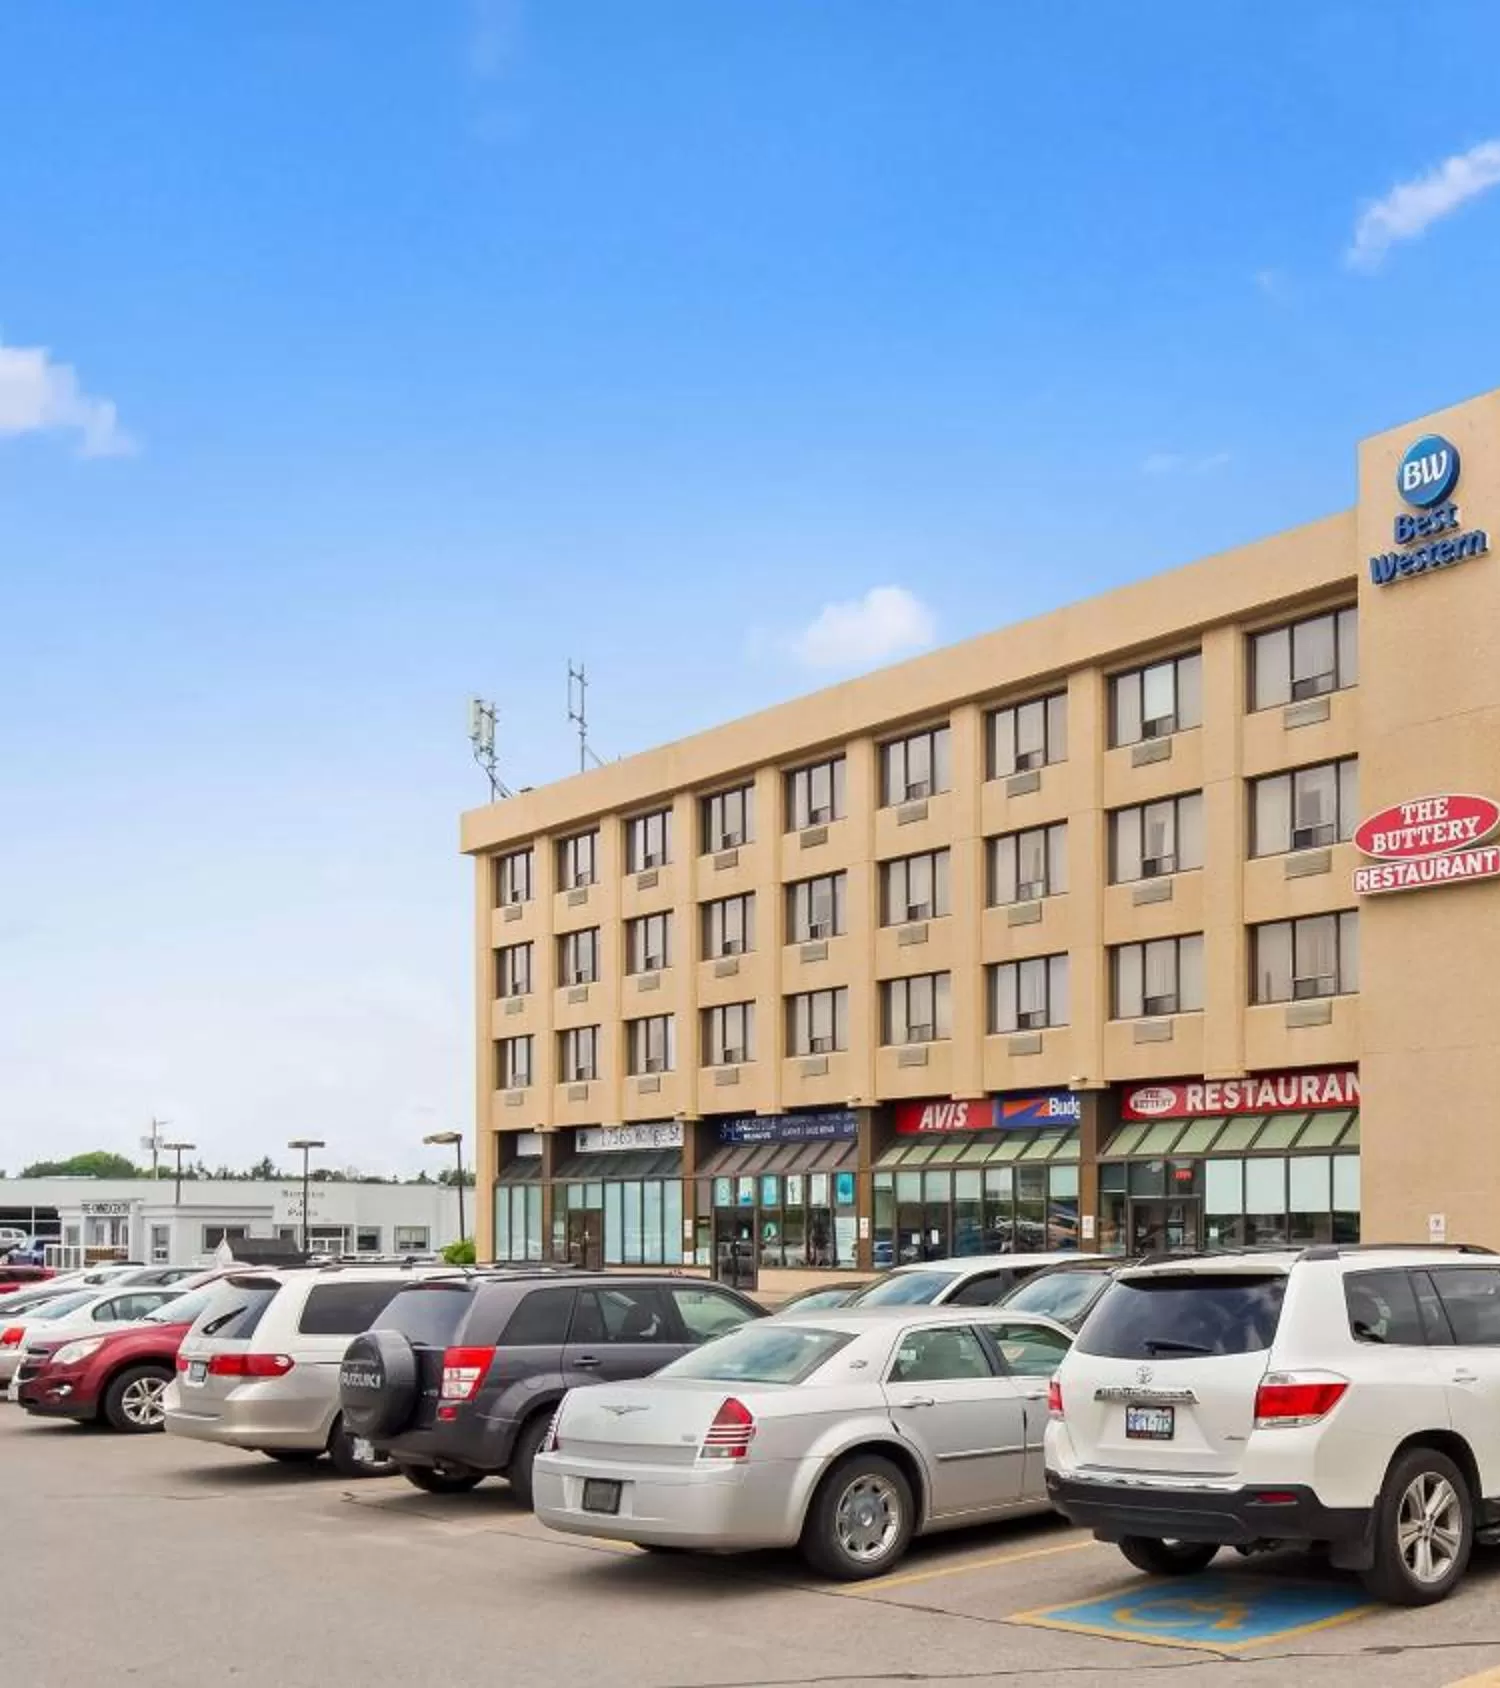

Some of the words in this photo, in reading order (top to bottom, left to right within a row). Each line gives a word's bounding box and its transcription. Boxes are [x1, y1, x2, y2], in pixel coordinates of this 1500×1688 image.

[1403, 450, 1447, 491] BW
[1394, 502, 1460, 544] Best
[1370, 530, 1489, 585] Western
[1401, 798, 1449, 825] THE
[1371, 816, 1481, 853] BUTTERY
[1355, 850, 1497, 891] RESTAURANT
[1049, 1095, 1080, 1119] Budg
[1186, 1071, 1361, 1112] RESTAURAN
[919, 1103, 969, 1130] AVIS
[341, 1371, 381, 1389] SUZUKI
